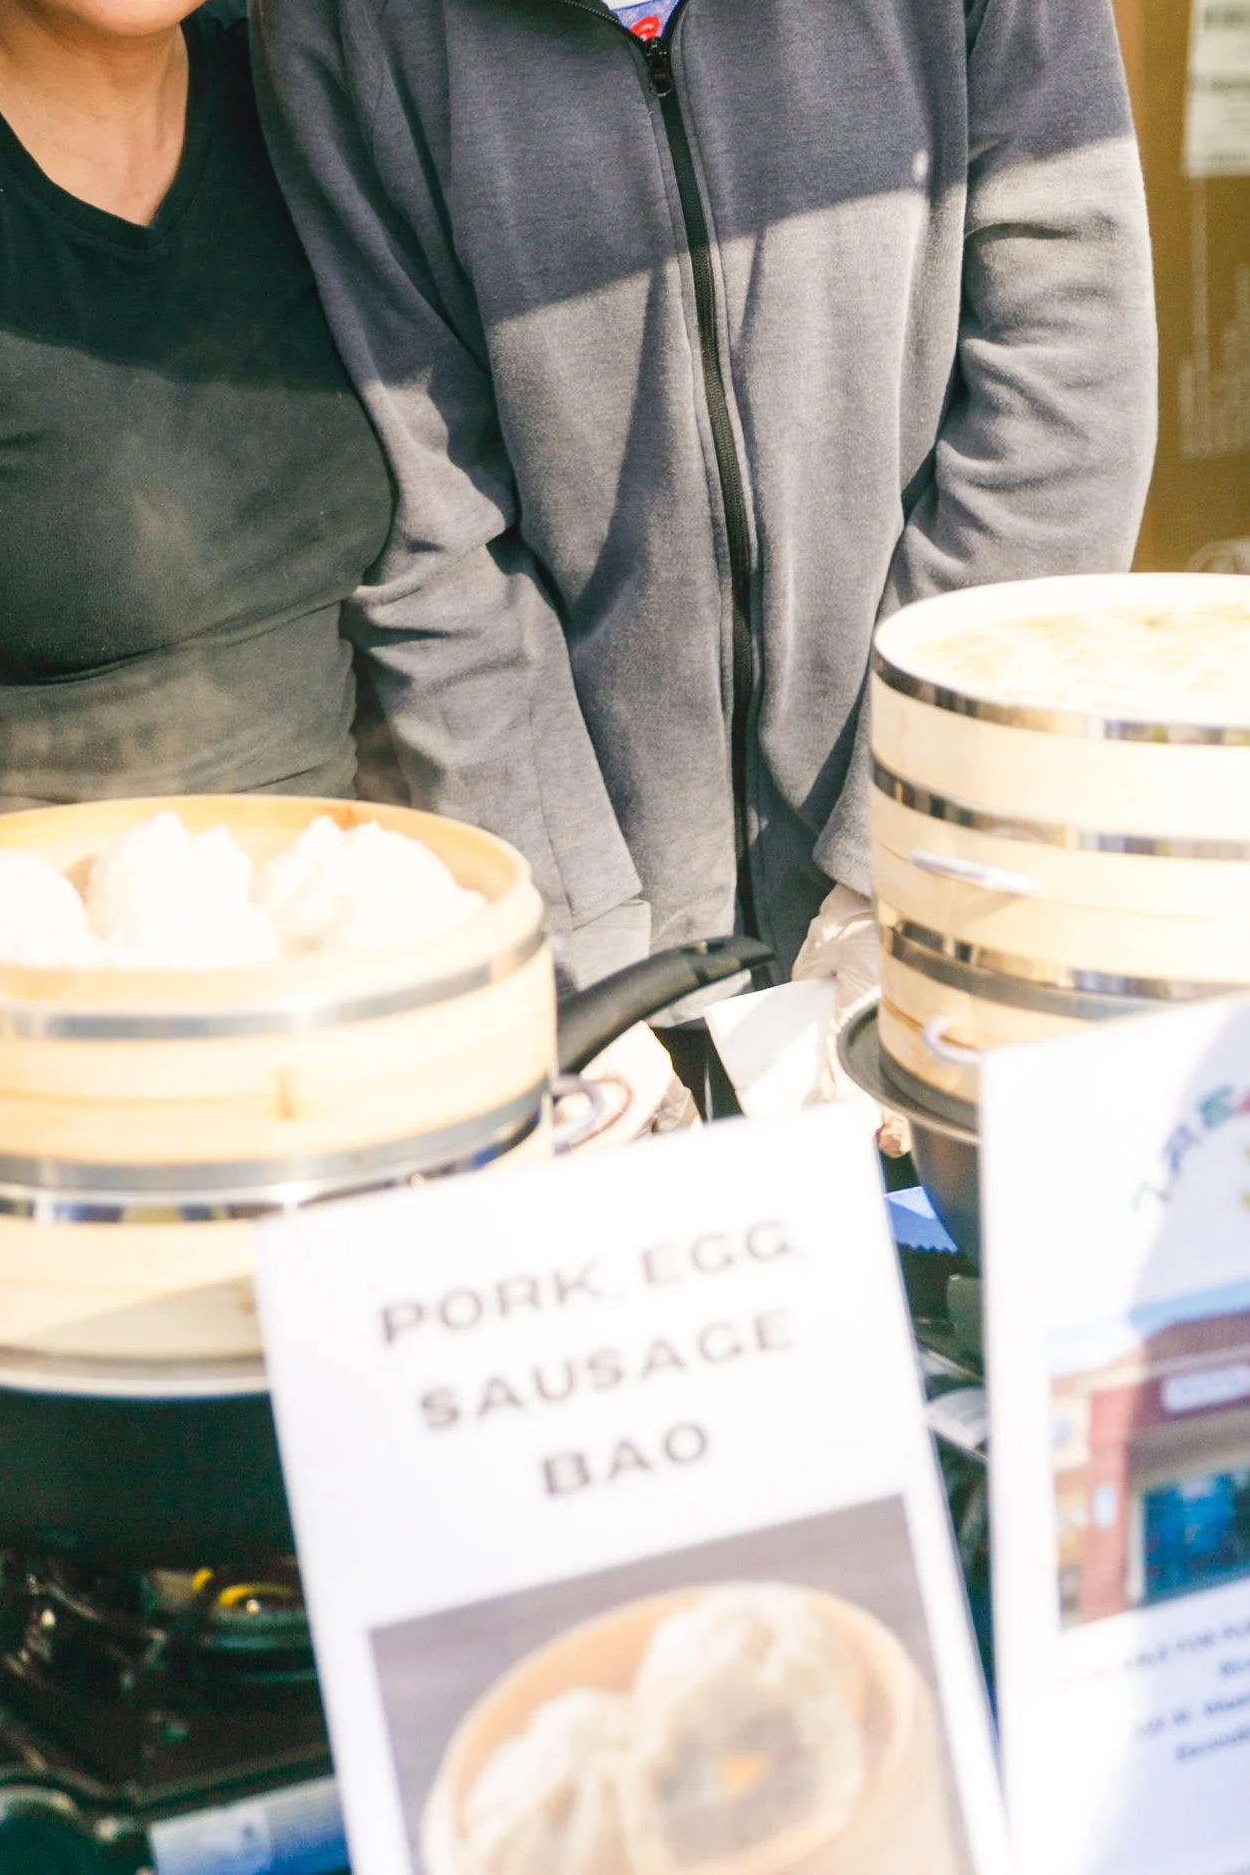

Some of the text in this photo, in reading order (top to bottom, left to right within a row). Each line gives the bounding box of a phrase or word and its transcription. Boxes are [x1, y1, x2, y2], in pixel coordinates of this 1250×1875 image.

[380, 1221, 796, 1347] PORK EGG
[418, 1305, 800, 1432] SAUSAGE
[540, 1421, 712, 1498] BAO
